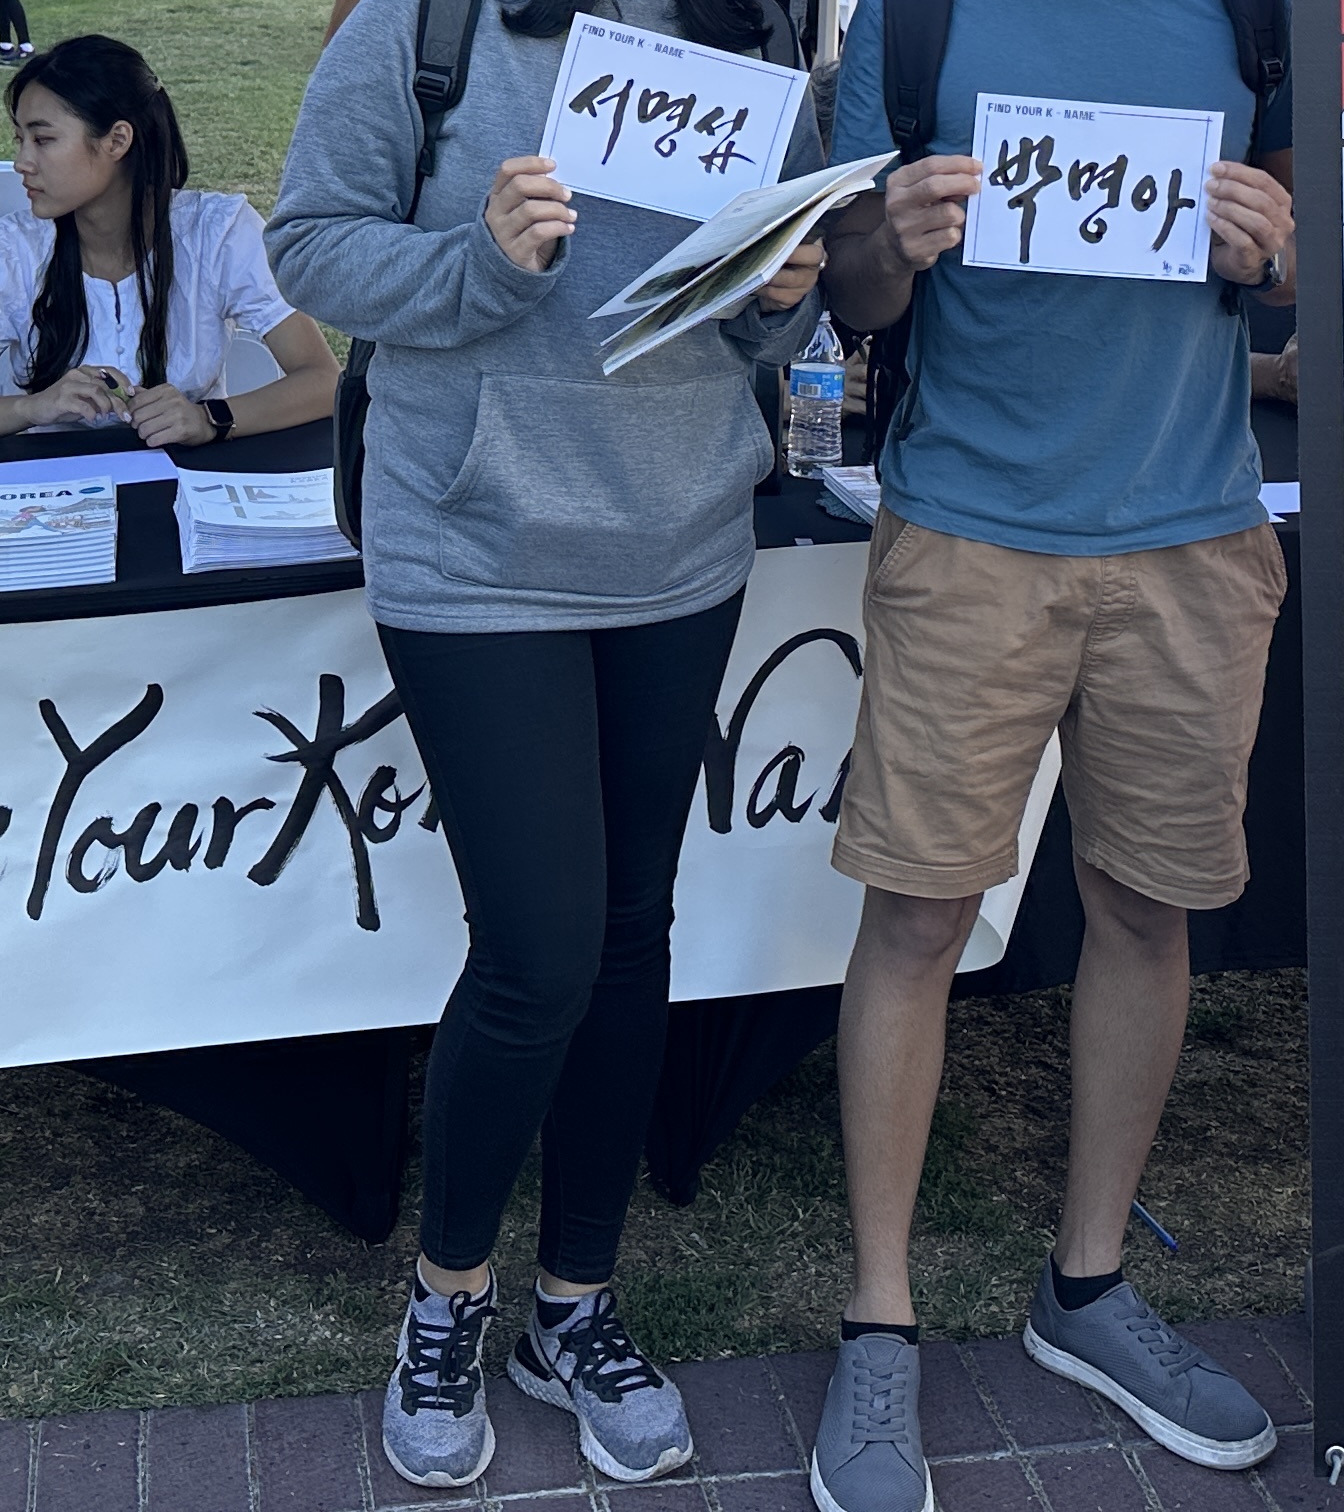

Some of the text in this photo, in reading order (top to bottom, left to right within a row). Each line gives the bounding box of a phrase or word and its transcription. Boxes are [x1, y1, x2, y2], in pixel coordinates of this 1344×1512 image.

[582, 23, 605, 38] FIND
[609, 30, 635, 45] YOUR
[637, 38, 645, 48] K
[654, 43, 685, 59] NAME
[988, 102, 1011, 114] FIND
[1016, 105, 1042, 116] YOUR
[1046, 108, 1053, 117] K
[1064, 109, 1095, 121] NAME
[24, 683, 277, 920] Your
